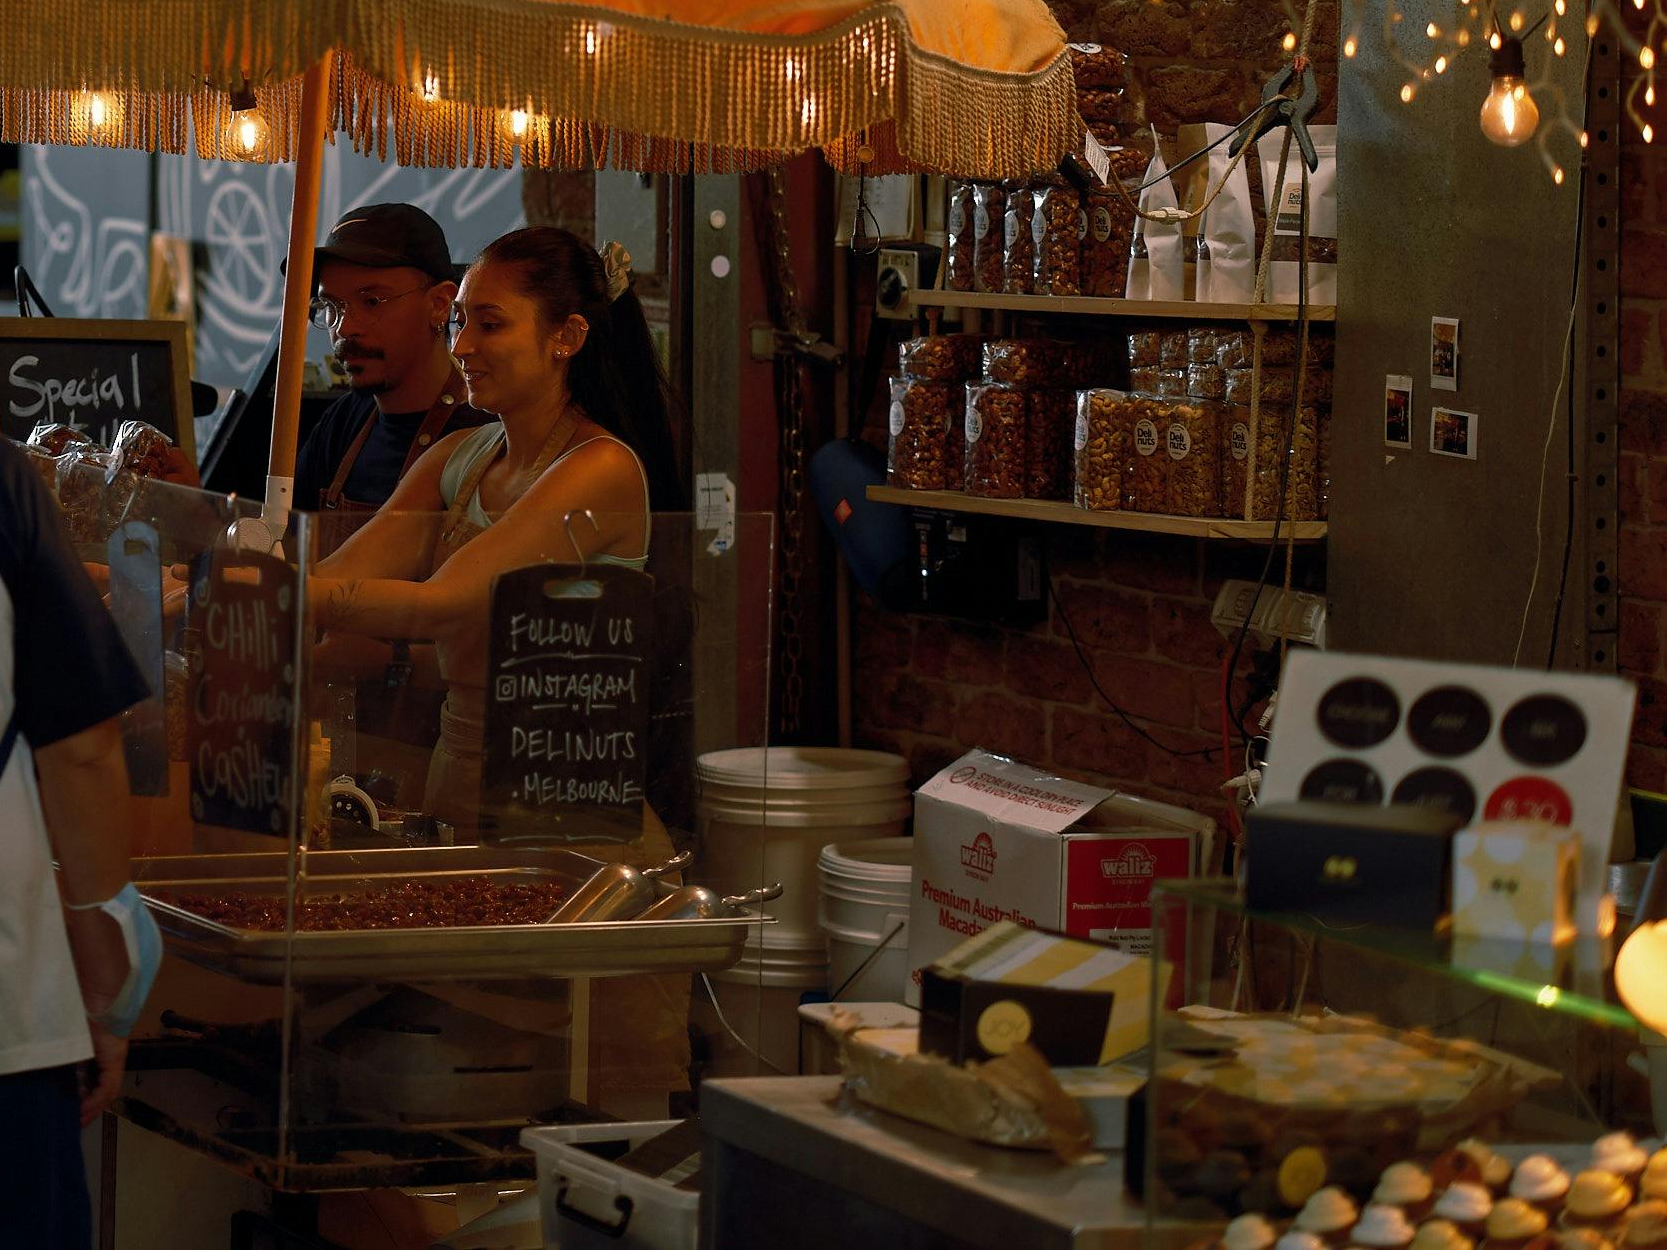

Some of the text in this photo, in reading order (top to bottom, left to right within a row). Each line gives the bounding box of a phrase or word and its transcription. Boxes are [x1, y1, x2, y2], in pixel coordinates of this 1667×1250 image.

[8, 352, 142, 419] Special
[1137, 428, 1152, 438] Deli
[1170, 432, 1184, 442] Deli
[1232, 431, 1245, 441] Deli
[1137, 437, 1156, 446] nuts
[1169, 441, 1187, 451] nuts
[510, 614, 633, 652] FOLLOW US
[520, 668, 636, 715] INSTAGRAM
[1008, 791, 1038, 806] DIRECT
[1036, 799, 1078, 815] SUNLIGHT
[921, 880, 971, 913] Premium
[1072, 902, 1104, 910] Premium
